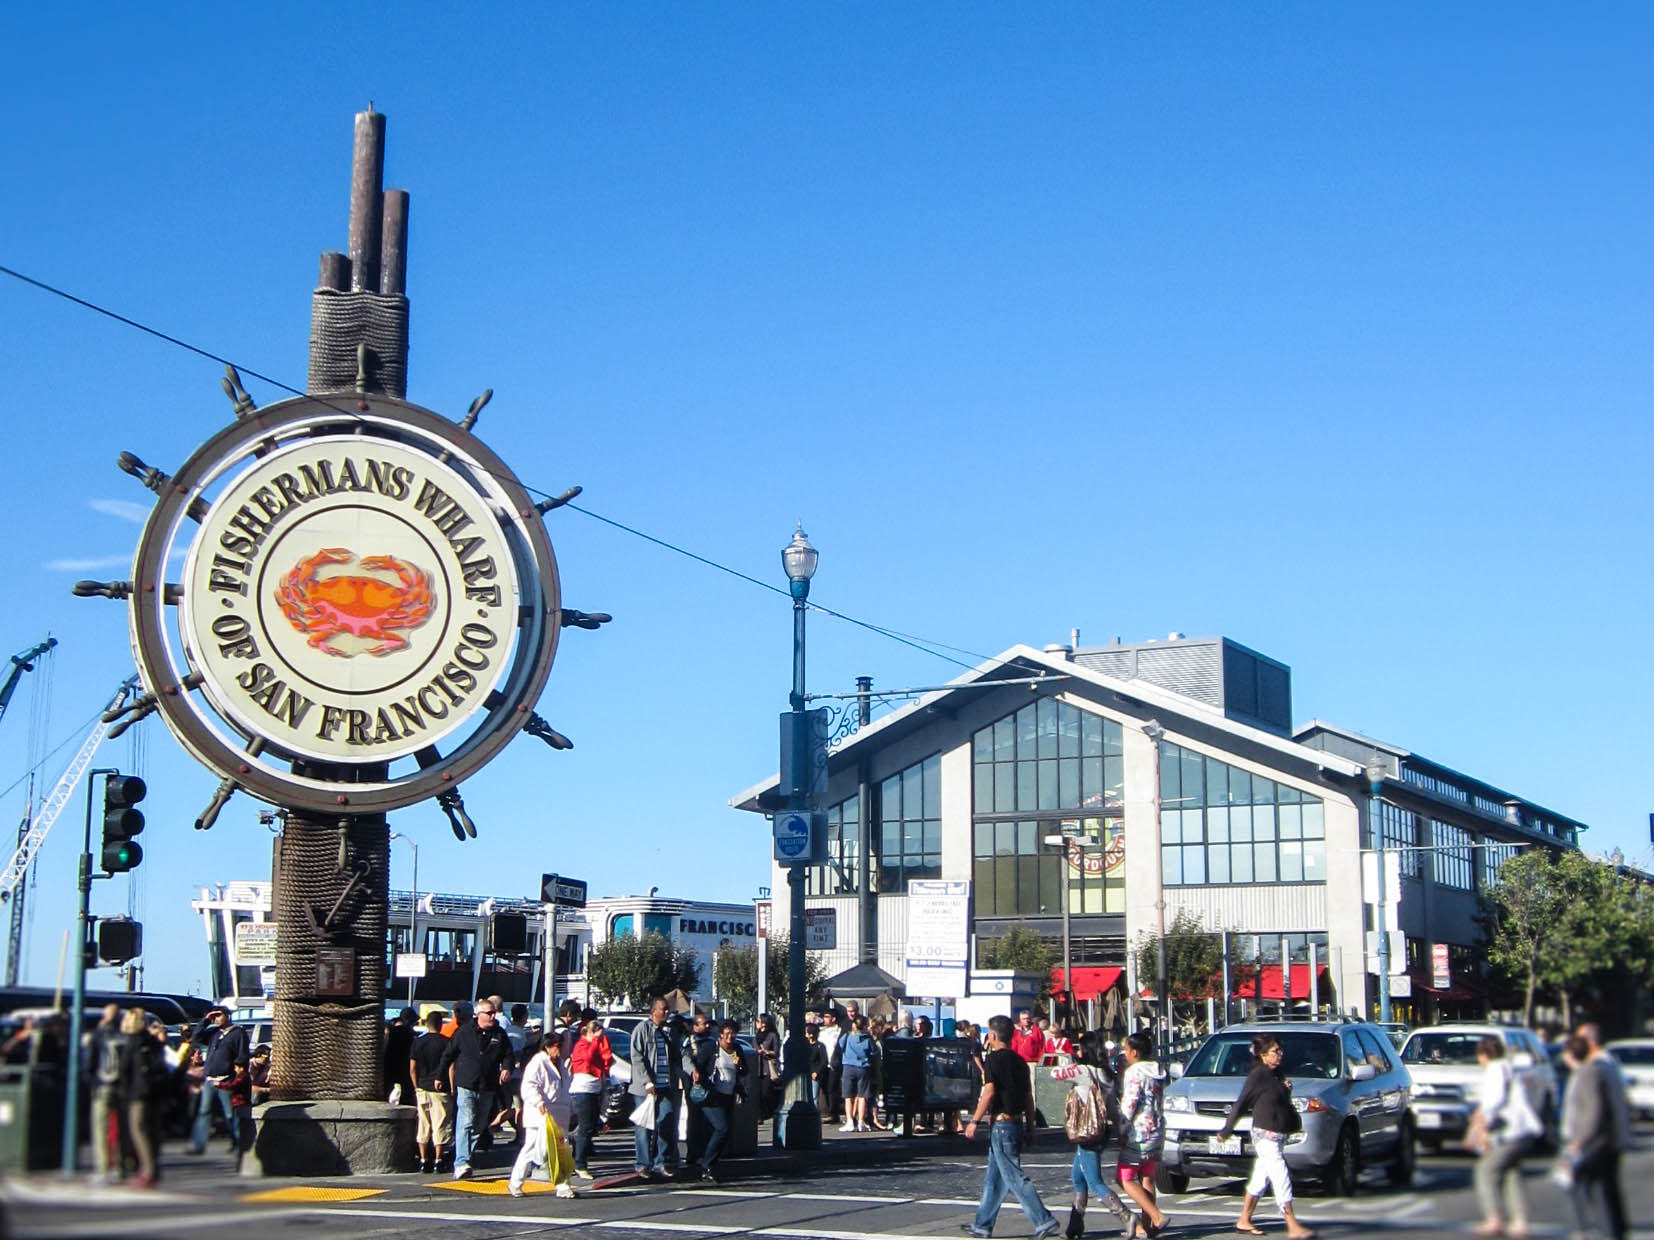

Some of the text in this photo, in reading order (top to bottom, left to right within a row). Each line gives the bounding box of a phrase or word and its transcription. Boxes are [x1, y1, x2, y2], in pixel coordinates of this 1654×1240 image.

[209, 457, 502, 607] FISHERMANS WHARF
[211, 614, 499, 745] OF SAN FRANCISCO
[555, 885, 584, 900] ONE WAY
[680, 919, 756, 936] FRANCISC
